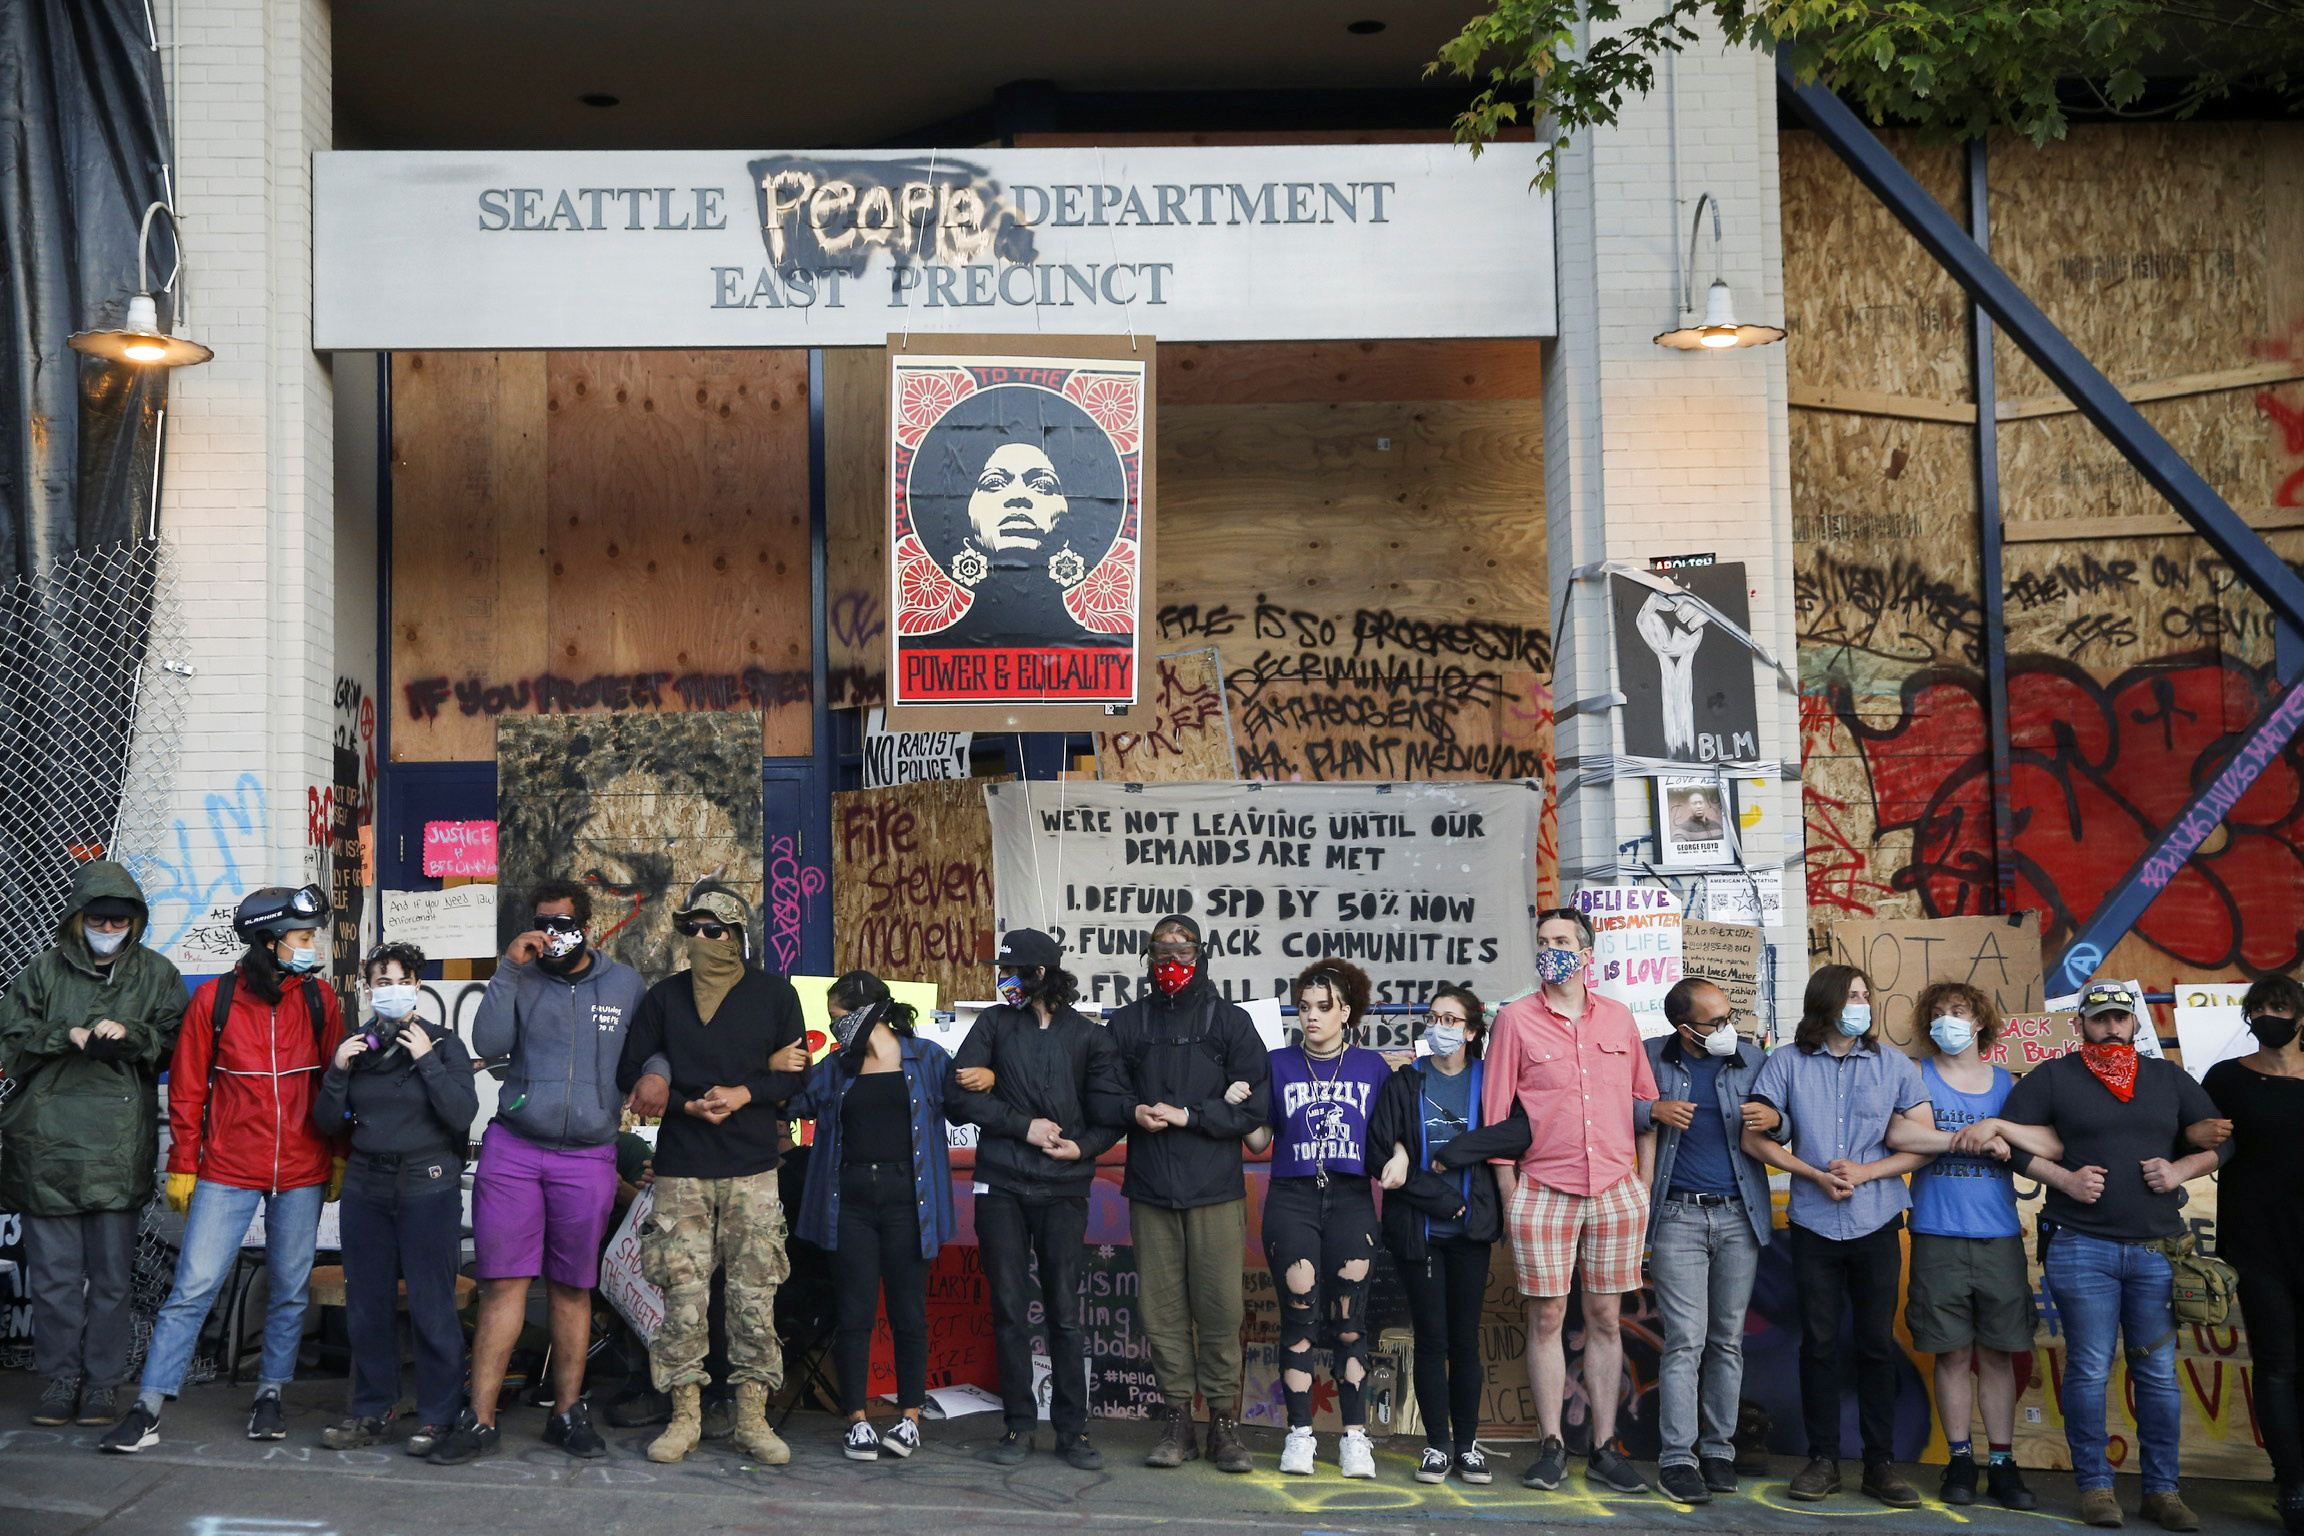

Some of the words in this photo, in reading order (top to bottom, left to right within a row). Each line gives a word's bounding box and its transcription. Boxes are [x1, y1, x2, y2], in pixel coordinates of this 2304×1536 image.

[477, 187, 727, 231] SEATTLE
[1010, 181, 1396, 227] DEPARTMENT
[710, 265, 852, 309] EAST
[886, 262, 1174, 308] PRECINCT
[973, 367, 1008, 386] TO
[1012, 368, 1067, 390] THE
[907, 655, 987, 692] POWER
[994, 654, 1011, 691] &
[1017, 653, 1132, 693] EQUALITY
[863, 734, 895, 788] NO
[898, 731, 962, 758] RACIST
[1698, 731, 1756, 761] BLM
[427, 826, 491, 848] JUSTICE
[1040, 809, 1112, 833] WE'RE
[1124, 811, 1180, 835] NOT
[1193, 812, 1317, 840] LEAVING
[1329, 814, 1416, 840] UNTIL
[1431, 814, 1486, 839] OUR
[1125, 838, 1251, 867] DEMANDS
[1257, 841, 1311, 868] ARE
[1325, 845, 1386, 871] MET
[1206, 888, 1265, 918] SPD
[1278, 889, 1320, 920] BY
[1337, 893, 1399, 922] 50%
[1410, 894, 1476, 923] NOW
[1581, 889, 1670, 914] BELIEVE
[1626, 913, 1681, 928] MATTER
[1282, 931, 1498, 965] COMMUNITIES
[1625, 932, 1671, 952] LIFE
[1603, 960, 1620, 981] IS
[1626, 956, 1680, 986] LOVE
[1836, 932, 1946, 992] NOT
[1283, 1080, 1372, 1120] GRIZZLY
[1934, 1108, 1976, 1125] Life
